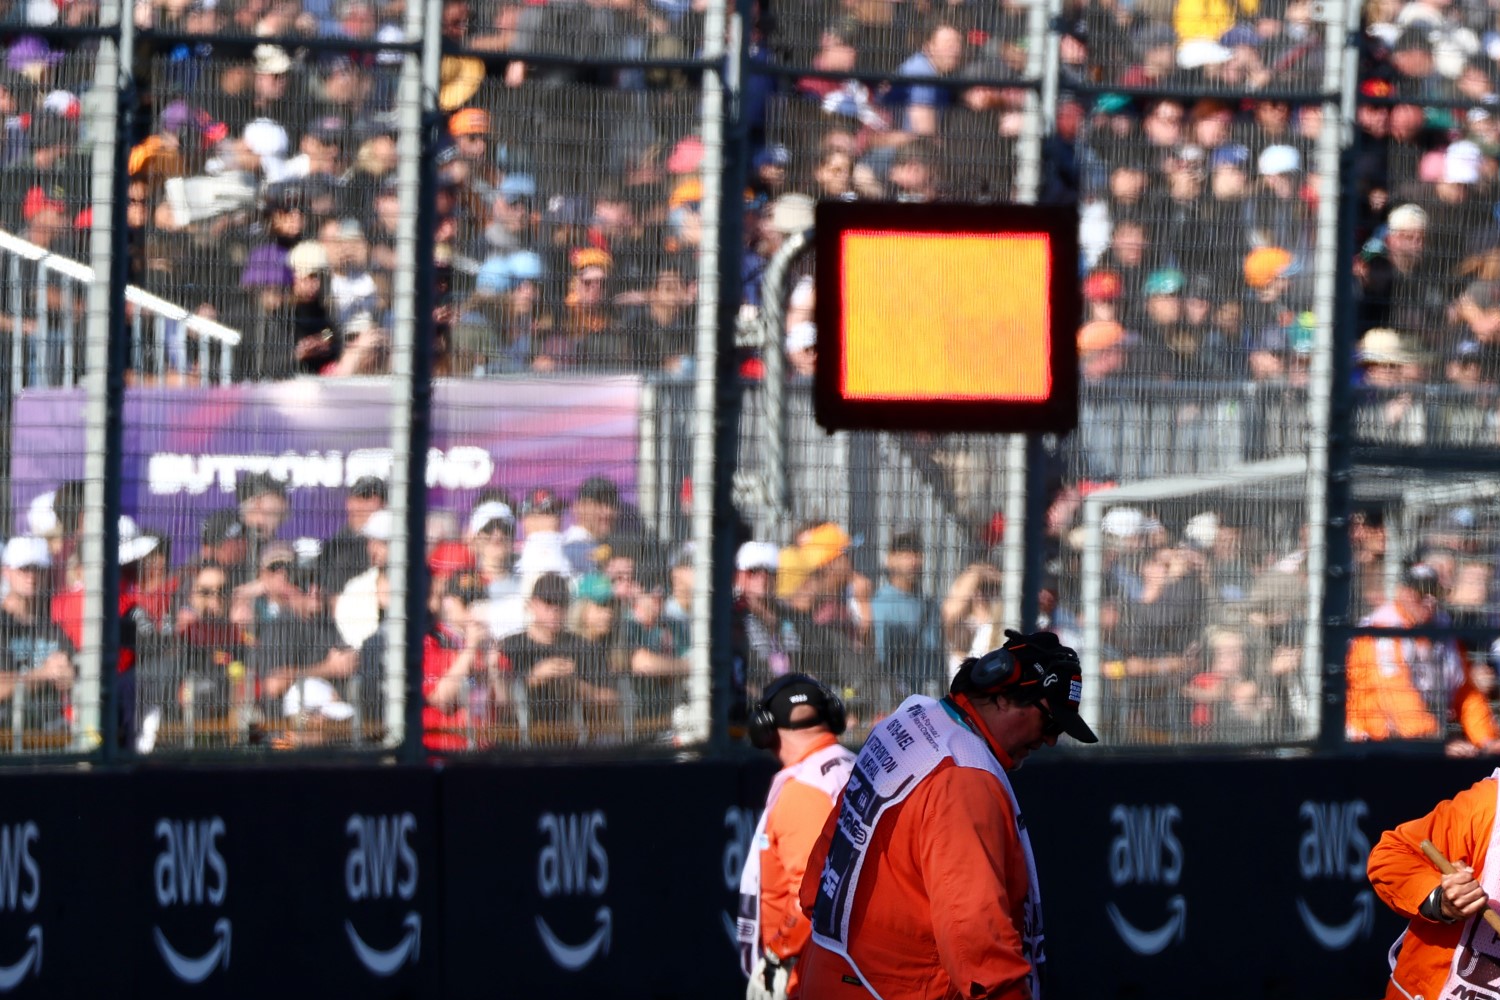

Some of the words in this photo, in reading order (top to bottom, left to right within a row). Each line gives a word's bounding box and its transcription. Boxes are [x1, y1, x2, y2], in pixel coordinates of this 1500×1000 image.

[0, 820, 40, 912] ws
[154, 815, 228, 907] aws
[345, 811, 419, 900] aws
[537, 809, 609, 897] aws
[1109, 804, 1184, 886] aws
[1299, 800, 1370, 880] aws
